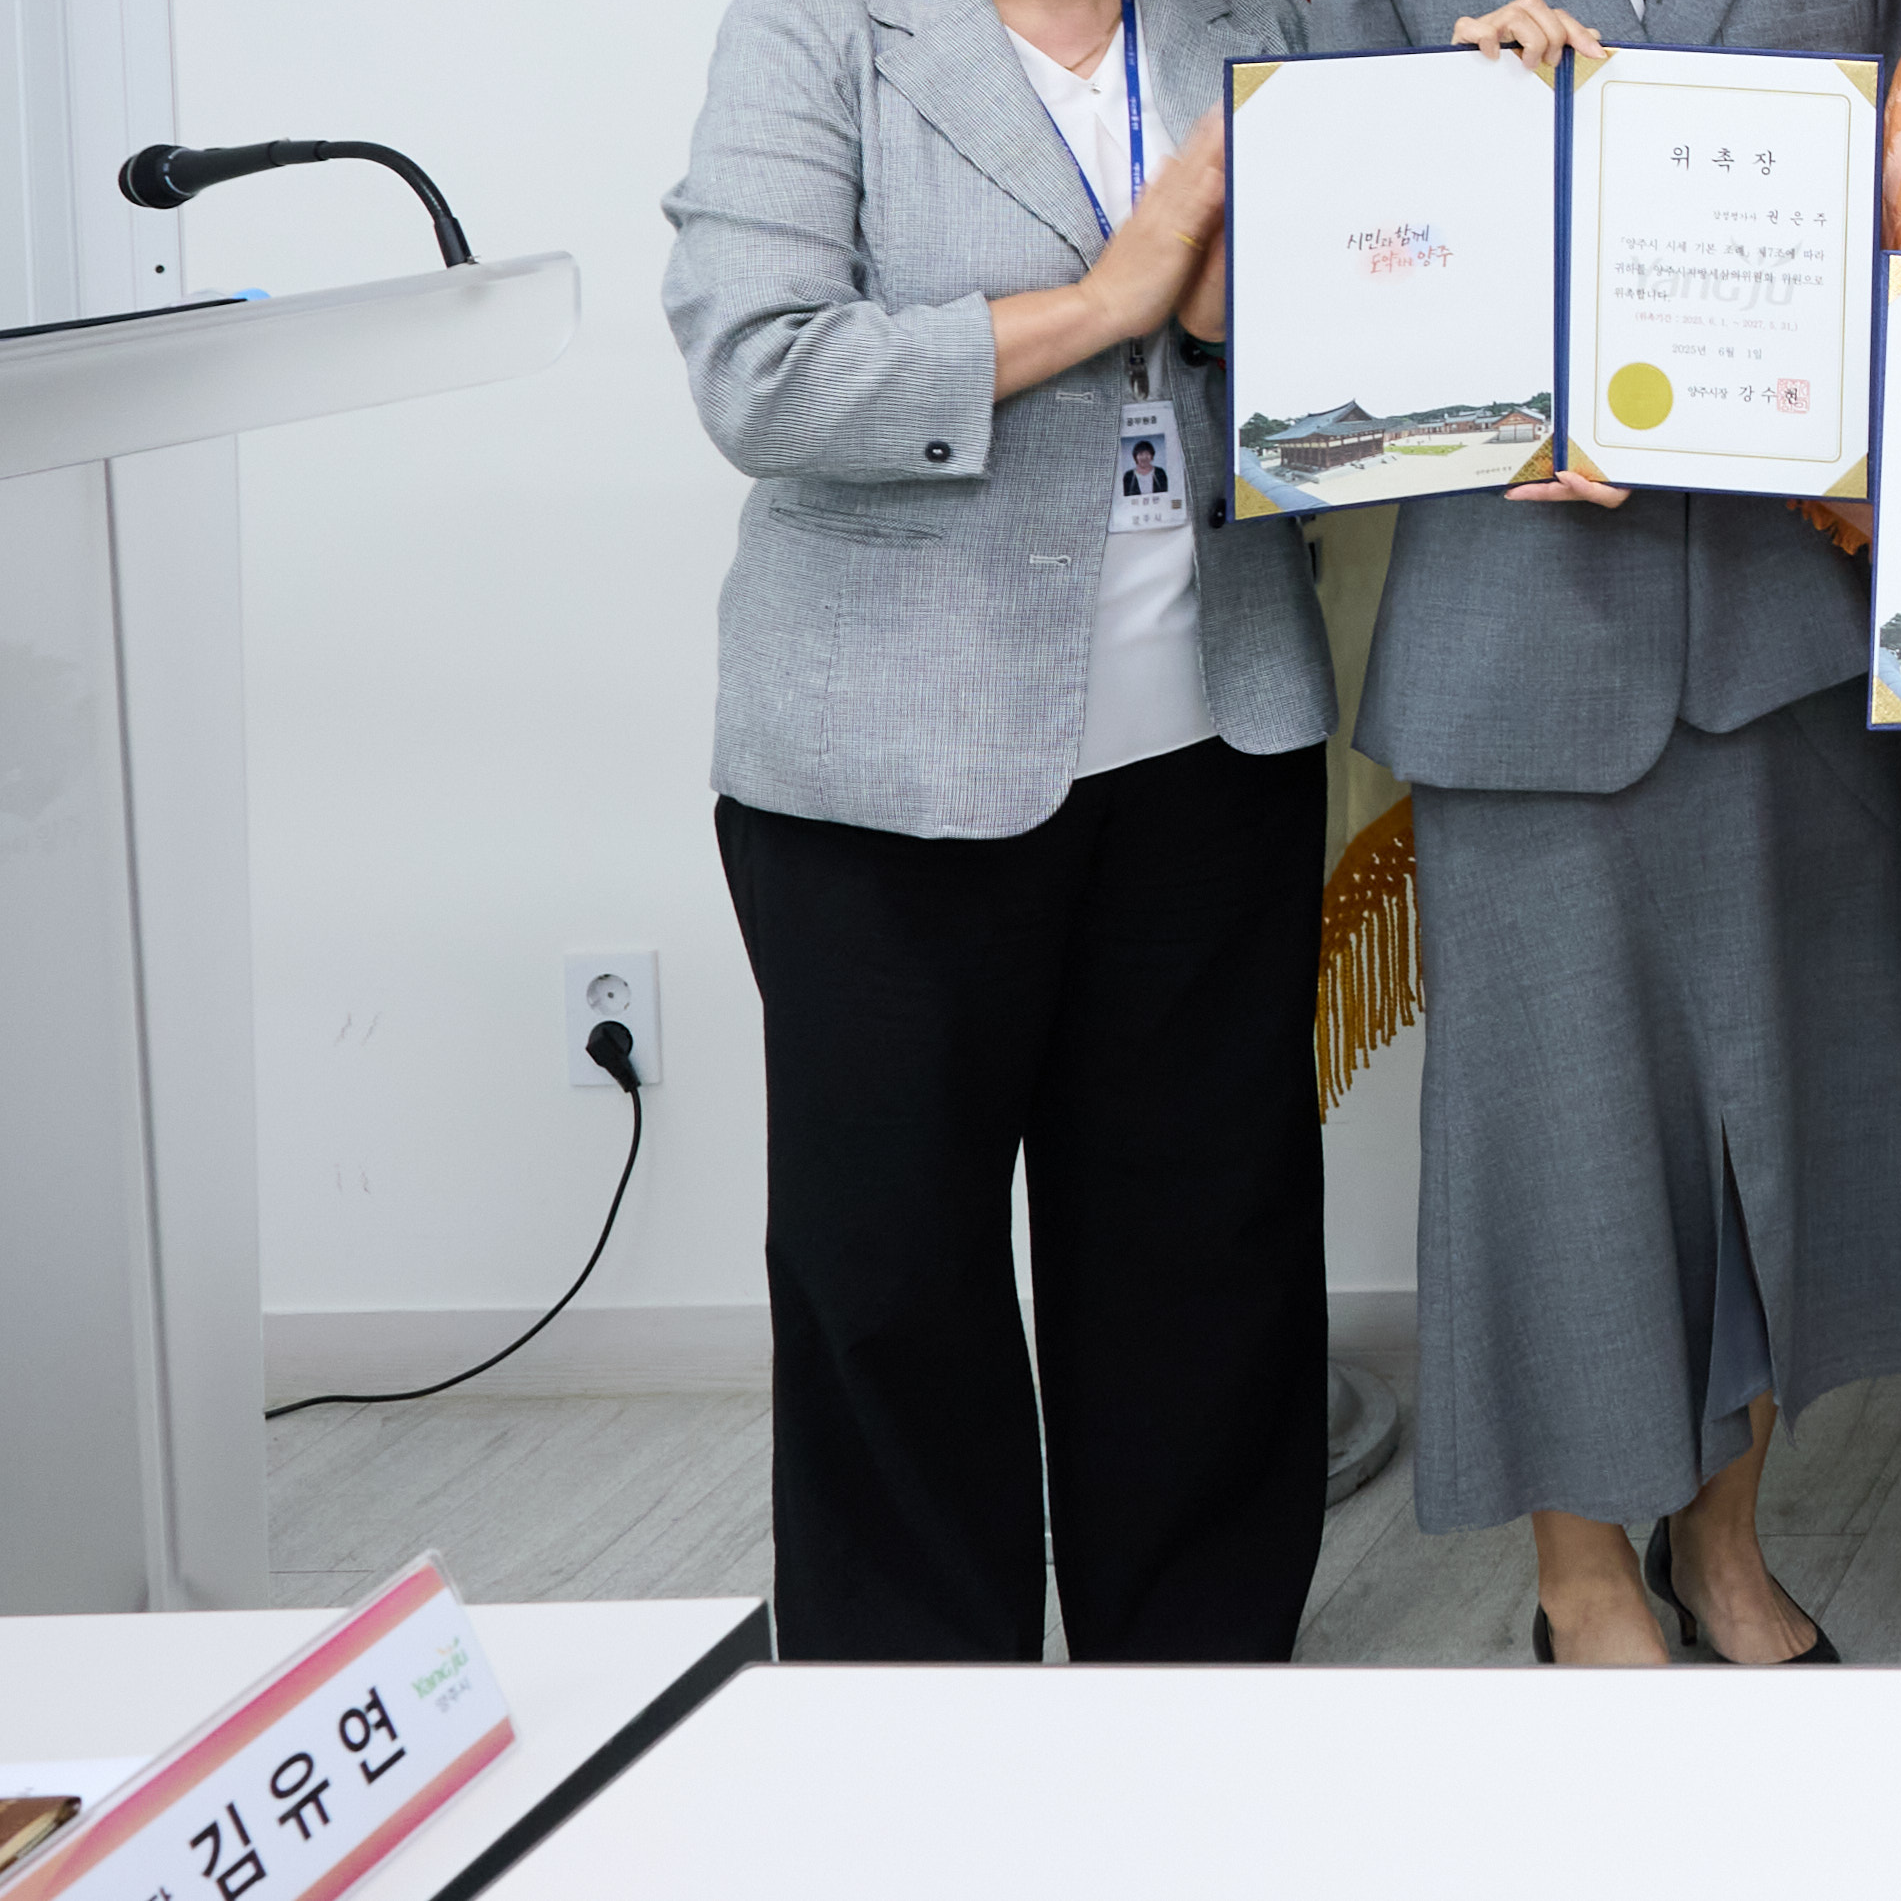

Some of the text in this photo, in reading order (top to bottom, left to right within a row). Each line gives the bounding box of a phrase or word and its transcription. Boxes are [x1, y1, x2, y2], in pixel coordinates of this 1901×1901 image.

[1395, 223, 1429, 247] 함께
[1417, 245, 1454, 267] 양주
[1804, 249, 1823, 261] 따라
